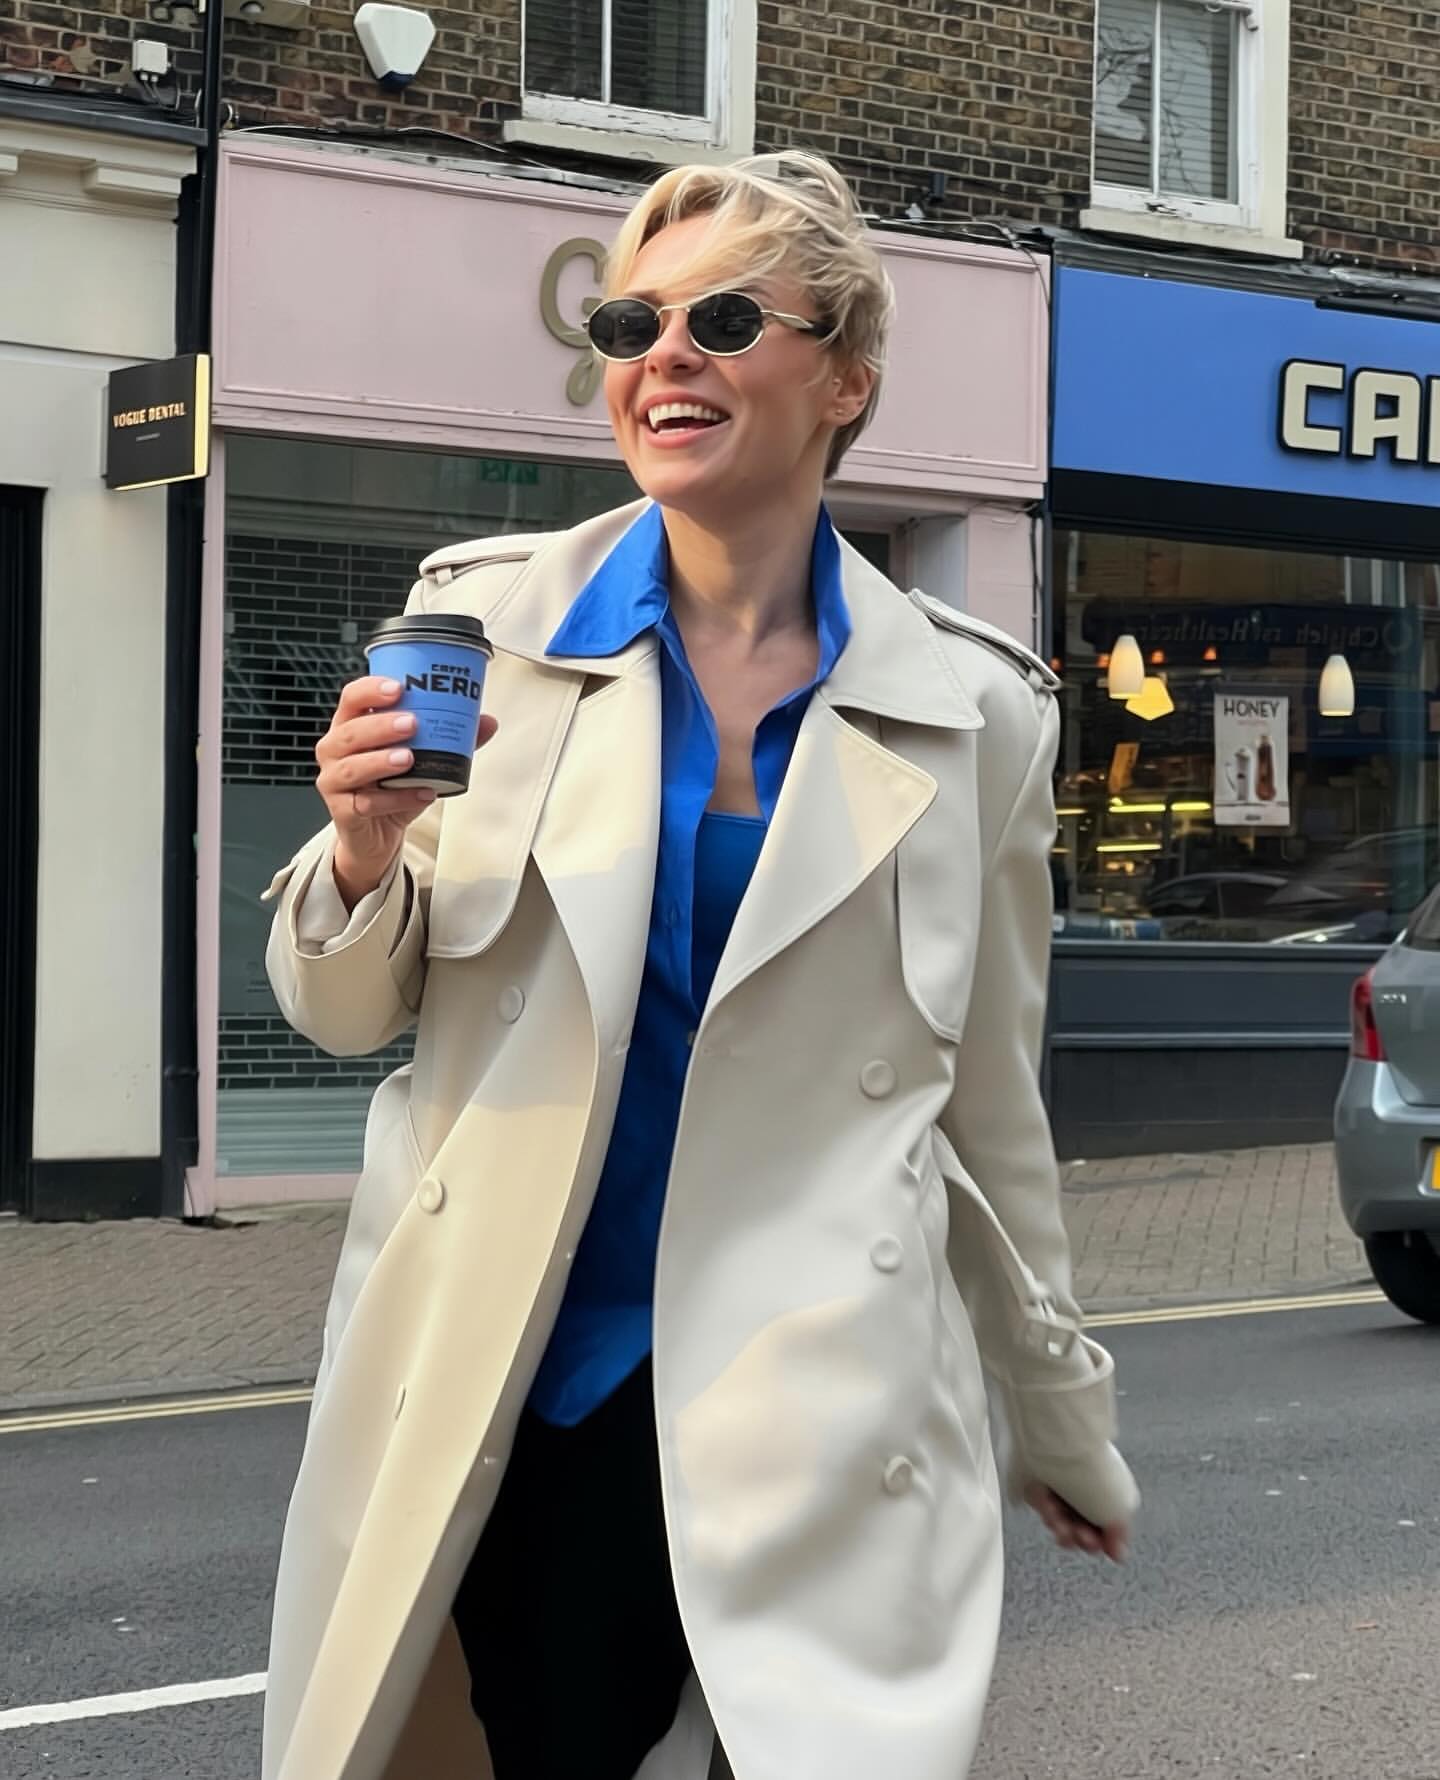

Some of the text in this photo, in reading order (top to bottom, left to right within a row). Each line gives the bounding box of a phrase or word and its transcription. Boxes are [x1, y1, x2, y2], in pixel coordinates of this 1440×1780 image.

[113, 402, 186, 428] VOGUE DENTAL
[1279, 358, 1440, 465] CA
[1223, 698, 1280, 718] HONEY
